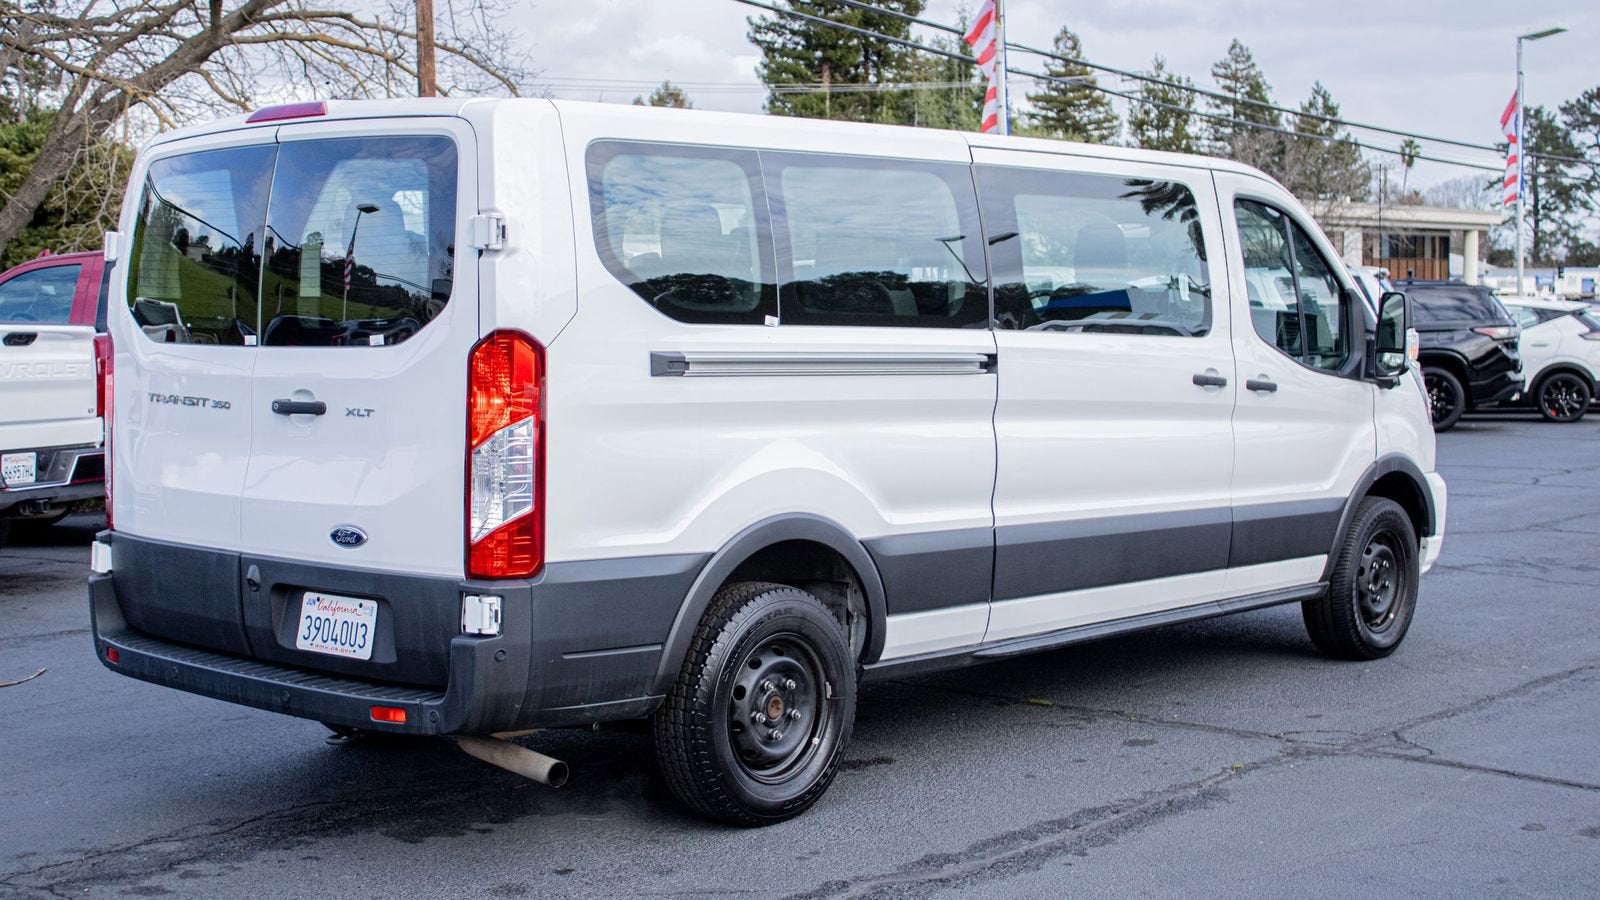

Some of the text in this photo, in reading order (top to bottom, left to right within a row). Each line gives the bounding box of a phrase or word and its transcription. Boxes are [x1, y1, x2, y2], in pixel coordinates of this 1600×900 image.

[148, 392, 231, 410] TRANSIT 350
[345, 407, 375, 418] XLT
[335, 530, 358, 544] Ford
[317, 598, 361, 616] California
[303, 615, 368, 648] 39040U3
